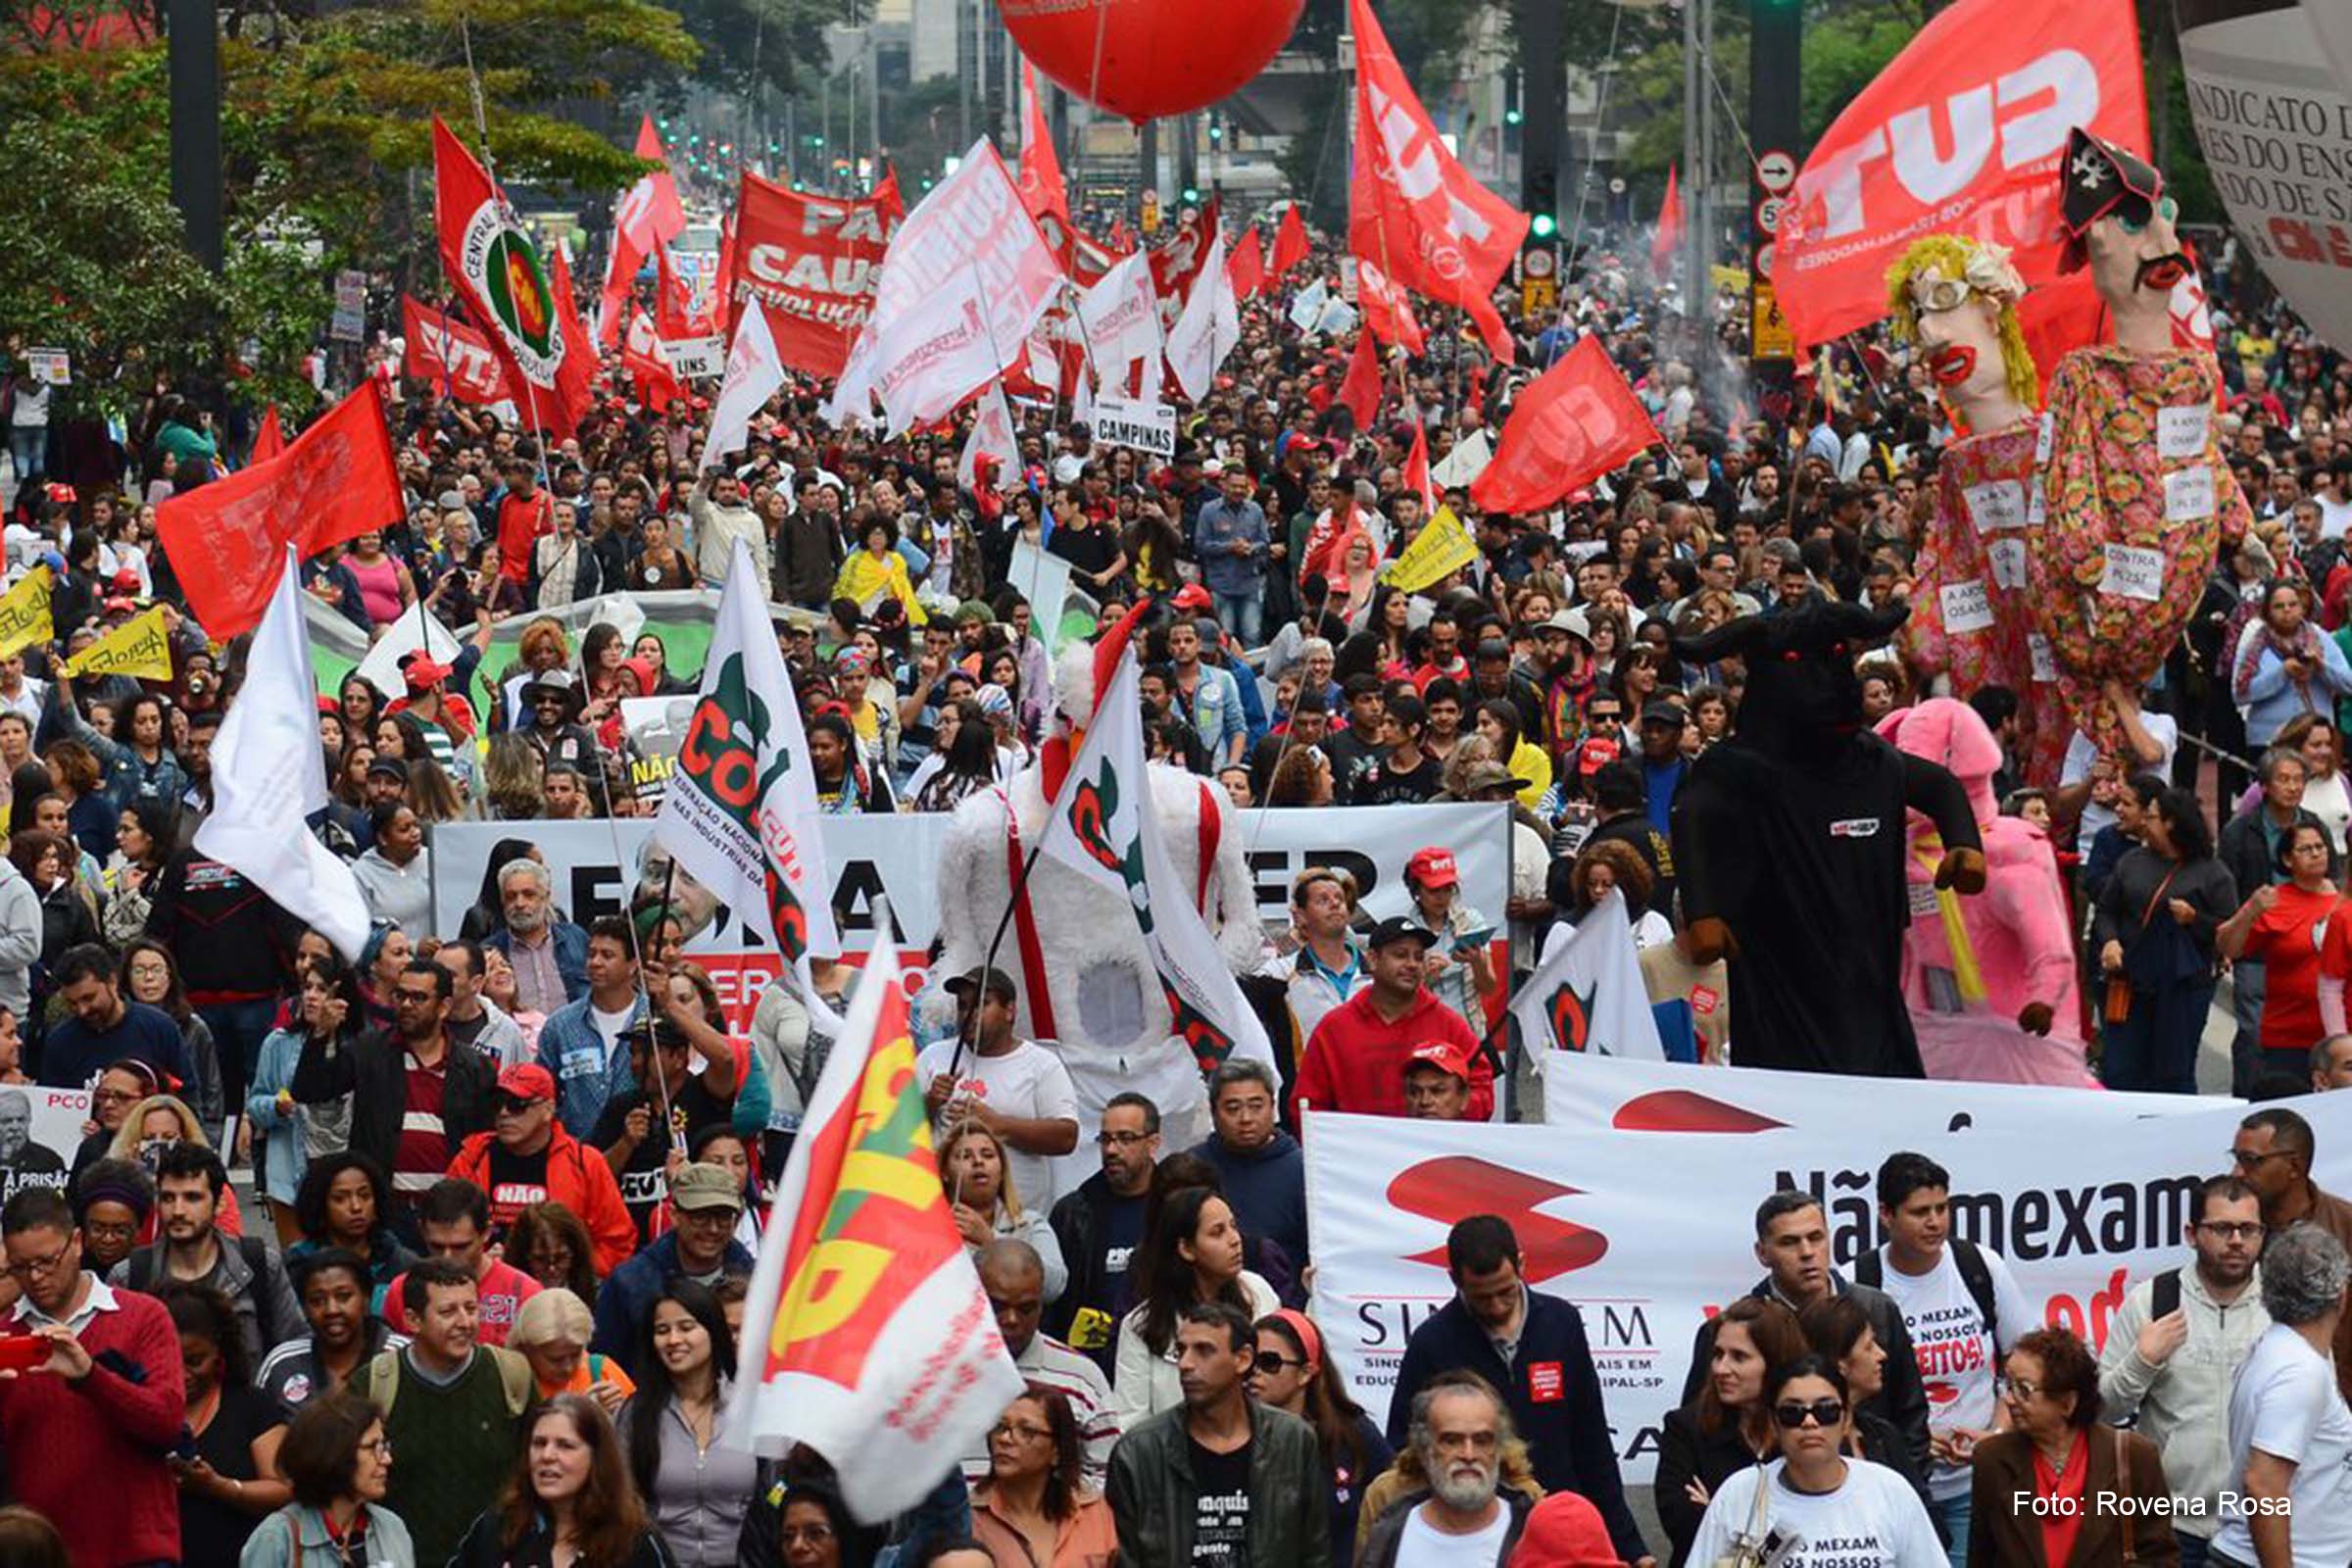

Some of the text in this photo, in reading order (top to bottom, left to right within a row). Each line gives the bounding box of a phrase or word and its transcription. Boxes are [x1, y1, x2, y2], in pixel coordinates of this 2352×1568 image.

[2243, 135, 2289, 174] DO
[2274, 180, 2320, 217] DE
[466, 212, 497, 279] CENTRAL
[677, 358, 708, 374] LINS
[1098, 417, 1171, 452] CAMPINAS
[670, 799, 692, 822] NAS
[746, 869, 765, 888] DA
[47, 1094, 89, 1110] PCO
[493, 1183, 546, 1203] NÃO
[1628, 1359, 1652, 1370] EM
[1914, 1335, 1984, 1377] EITOS!
[1601, 1377, 1664, 1389] IPAL-SP
[1815, 1536, 1880, 1552] MEXAM
